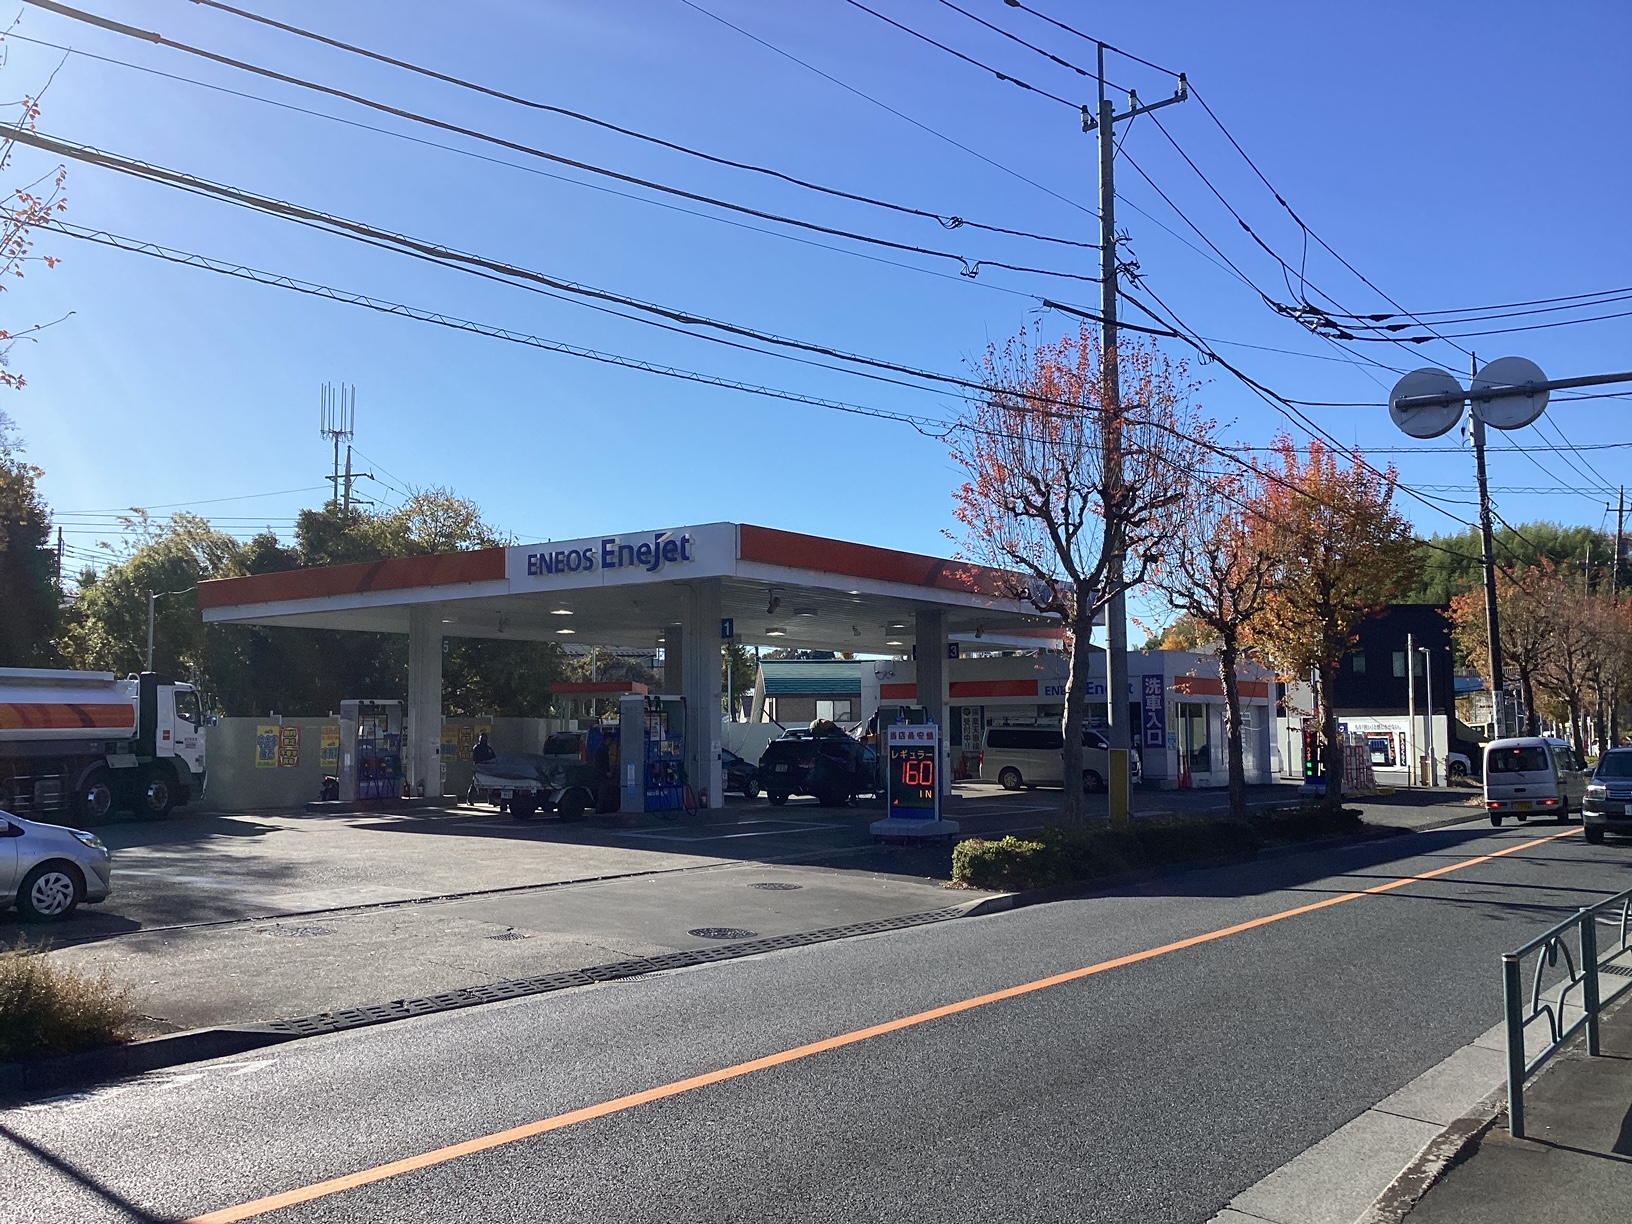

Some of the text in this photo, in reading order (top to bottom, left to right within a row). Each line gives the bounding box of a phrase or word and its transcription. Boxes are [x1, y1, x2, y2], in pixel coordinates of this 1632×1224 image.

[527, 532, 692, 576] ENEOS Enejet
[724, 622, 729, 635] 1
[444, 641, 449, 652] 5
[950, 646, 957, 657] 3
[1045, 686, 1066, 696] ENE
[1144, 677, 1162, 745] 洗車入口
[891, 749, 933, 759] レギュラー
[902, 760, 933, 785] 160
[919, 789, 932, 798] IN
